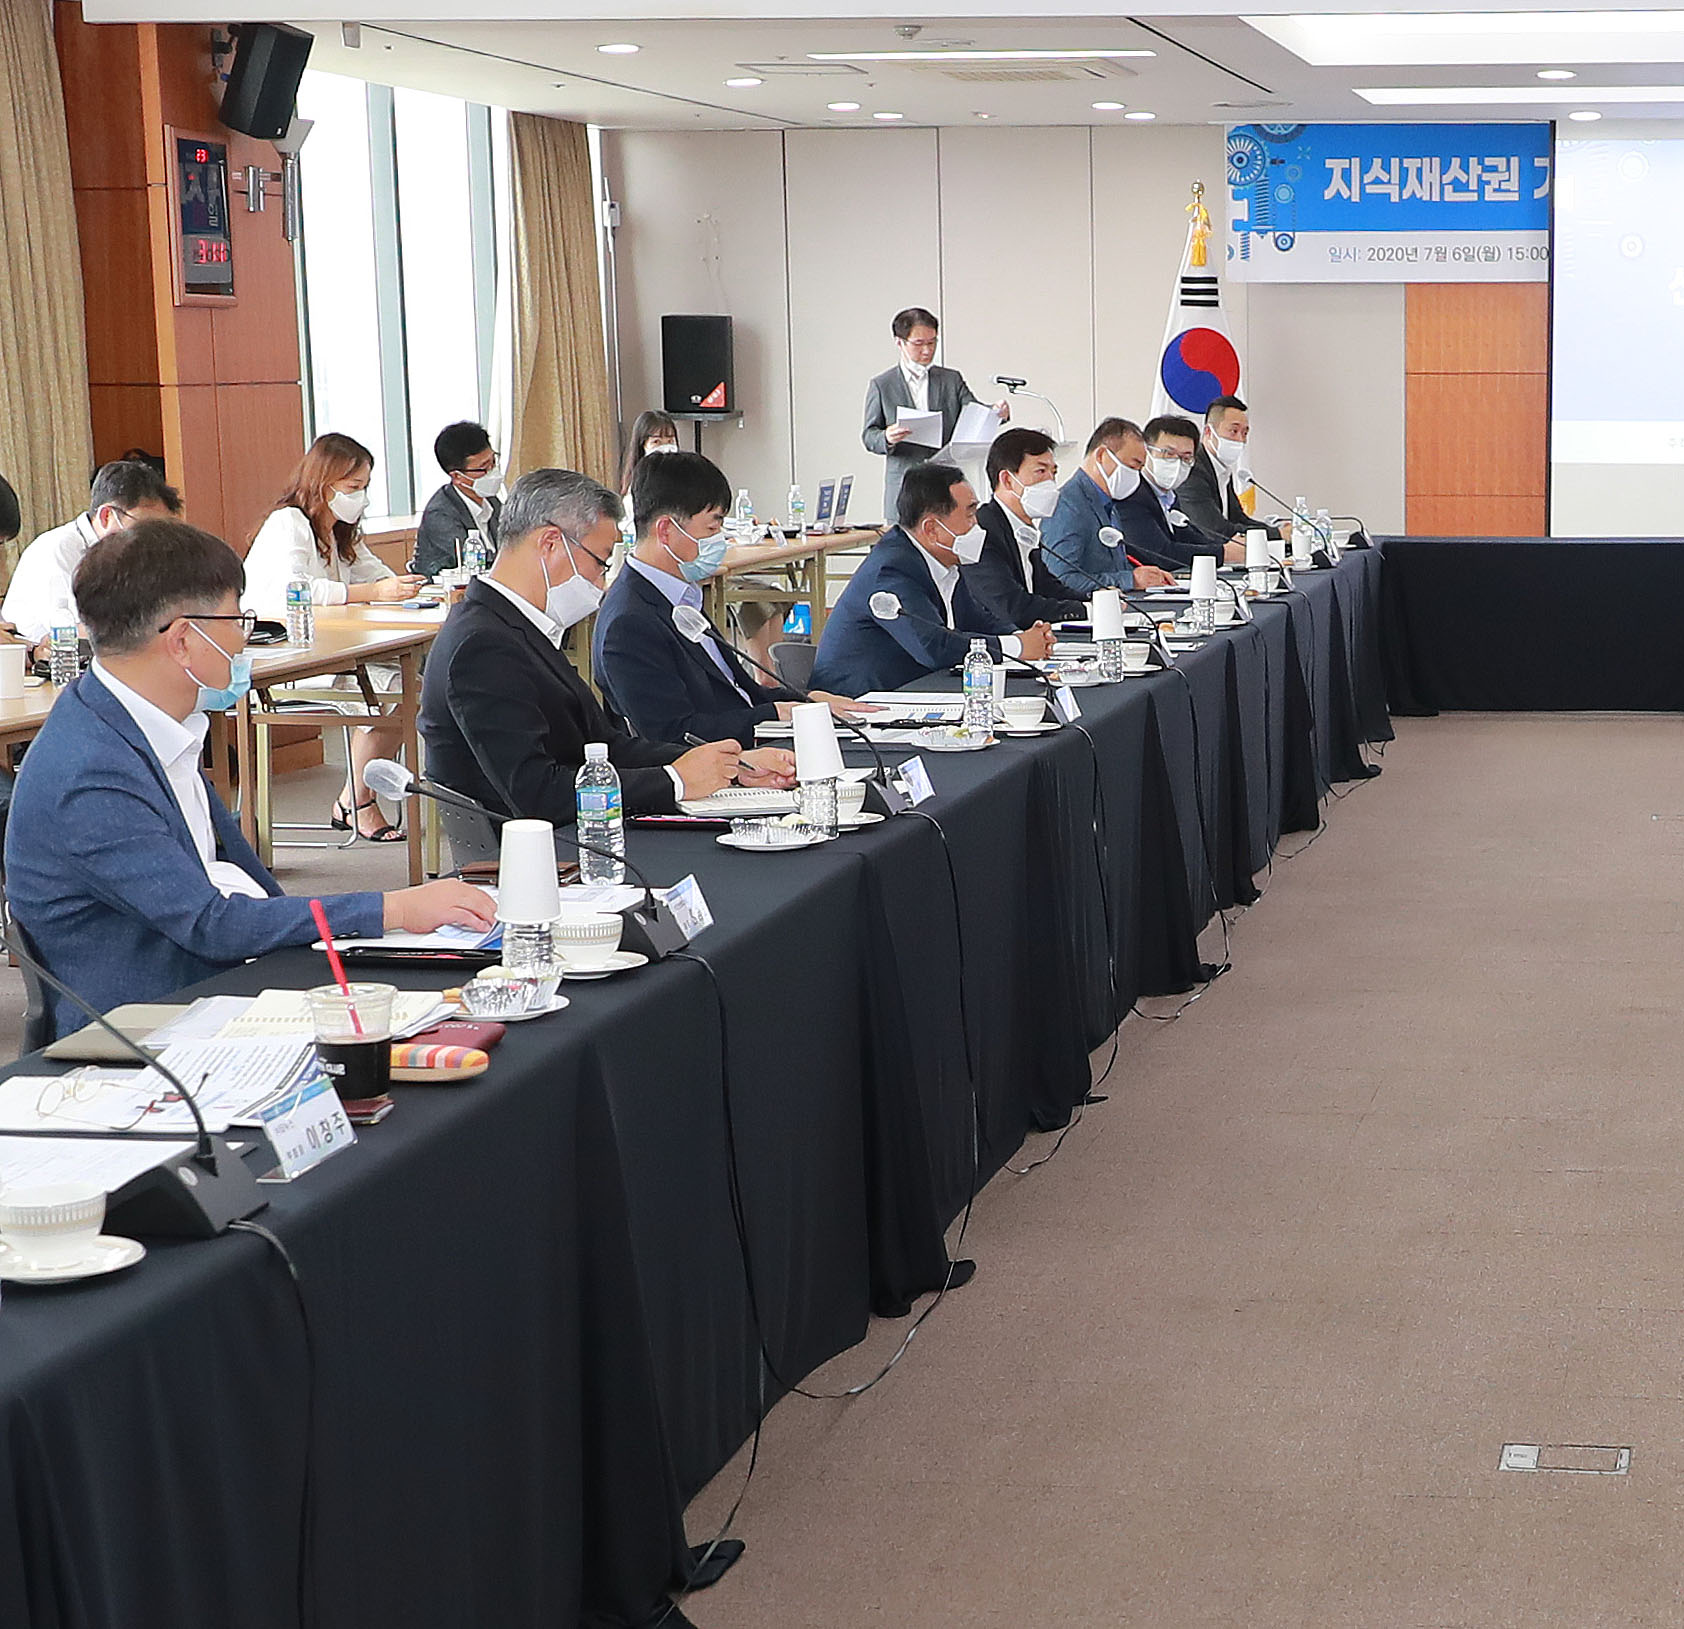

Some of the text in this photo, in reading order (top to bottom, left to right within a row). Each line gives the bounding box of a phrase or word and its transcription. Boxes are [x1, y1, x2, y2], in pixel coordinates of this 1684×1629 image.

[1323, 156, 1520, 202] 지식재산권
[1328, 246, 1549, 263] 일시: 2020년 7월 6일(월) 15:00
